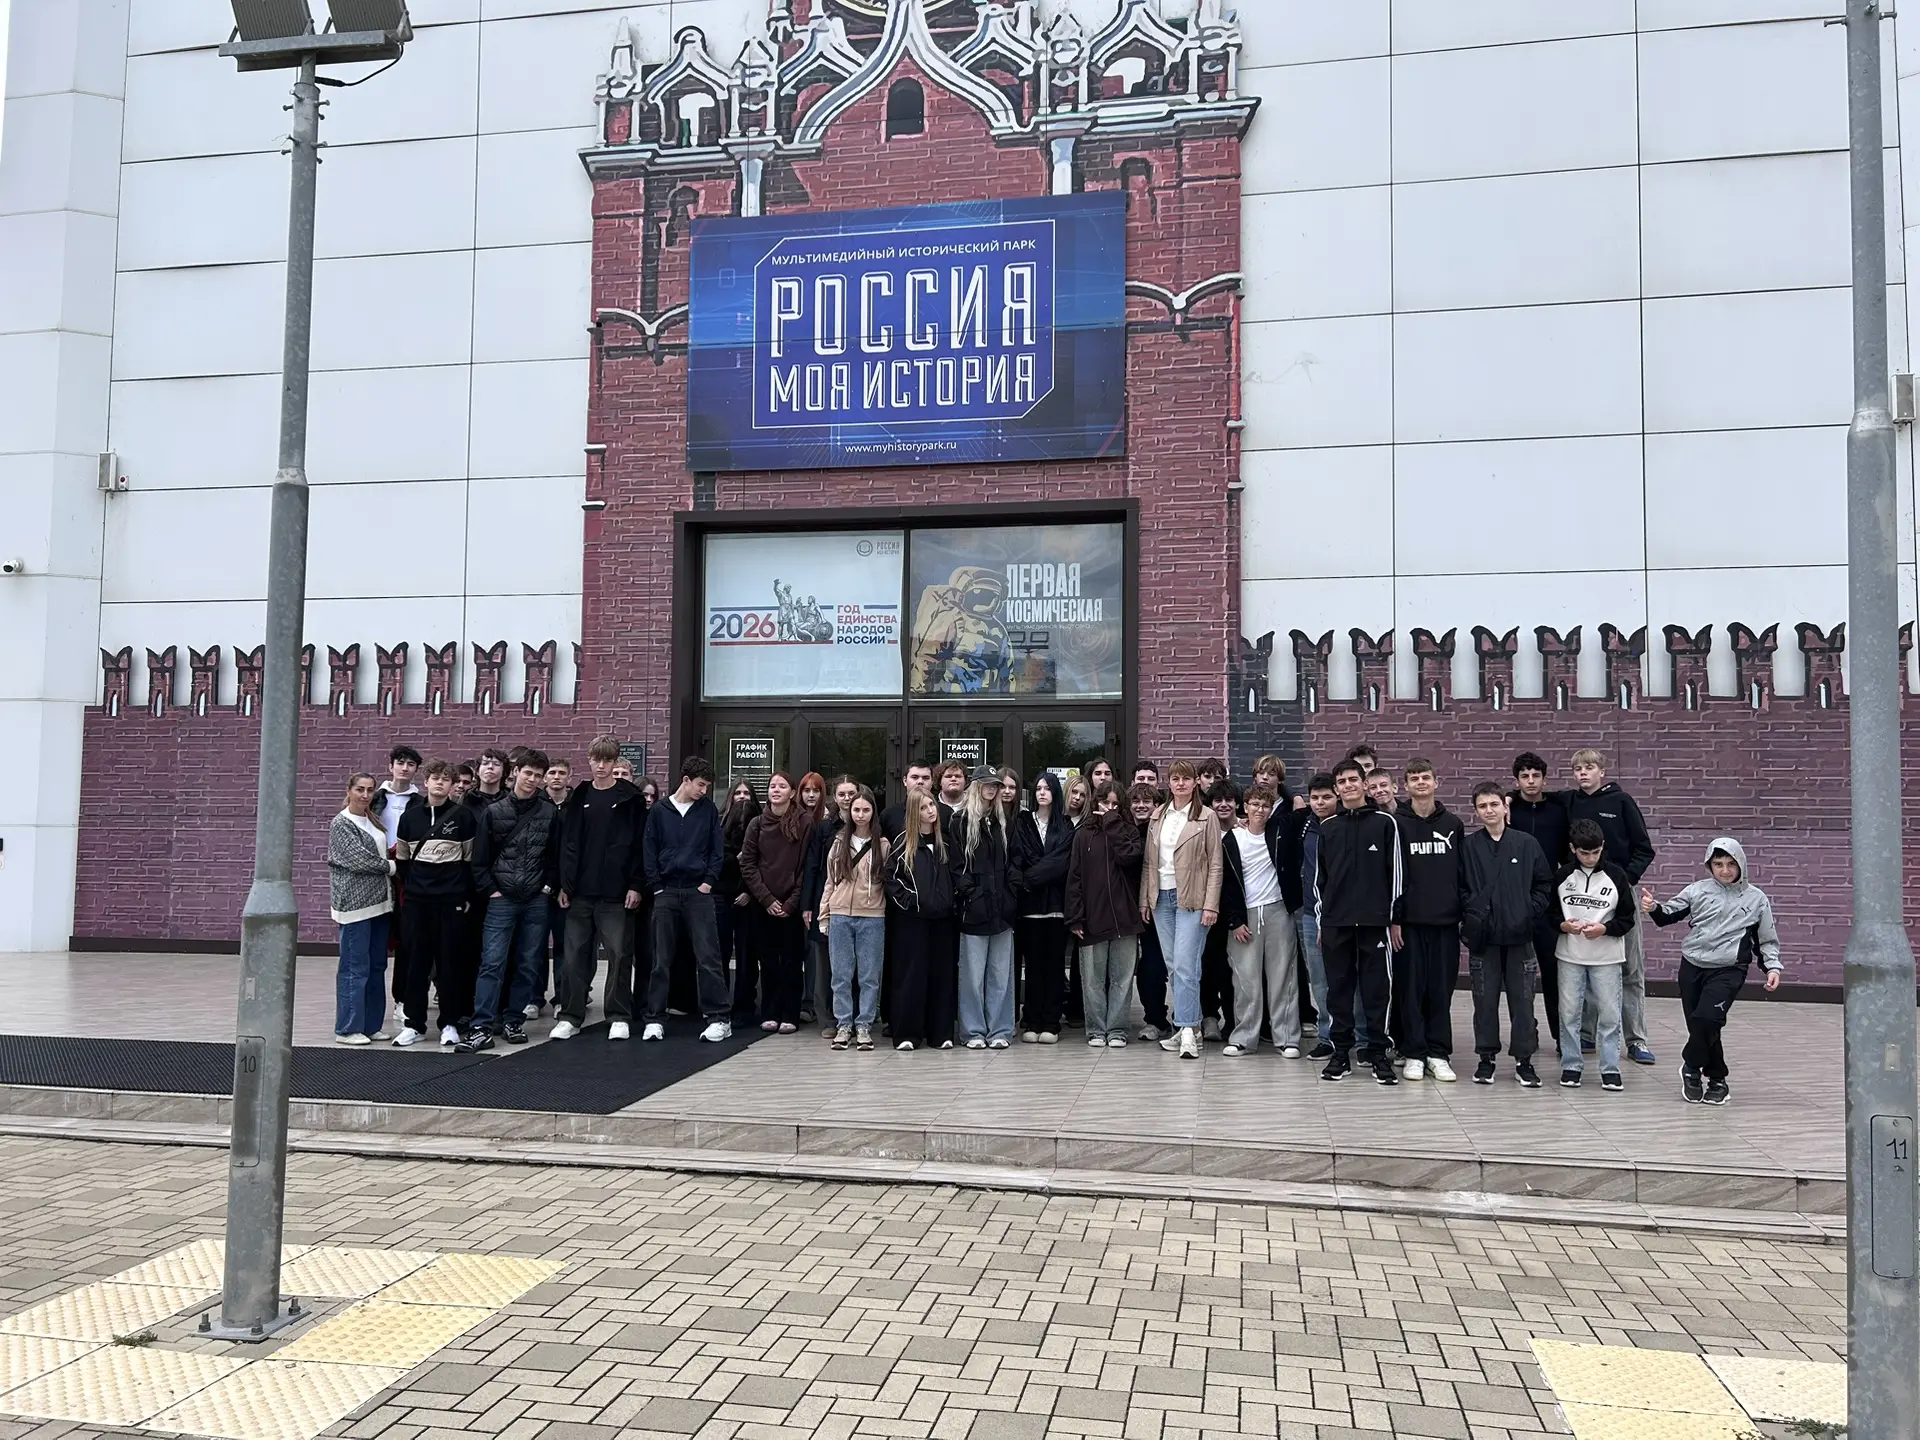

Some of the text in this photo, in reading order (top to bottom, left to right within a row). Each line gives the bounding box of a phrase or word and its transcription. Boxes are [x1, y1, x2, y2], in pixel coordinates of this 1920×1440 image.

[771, 239, 1037, 266] МУЛЬТИМЕДИЙНЫЙ ИСТОРИЧЕСКИЙ ПАРК
[770, 261, 1036, 358] РОССИЯ
[769, 352, 1036, 413] МОЯ ИСТОРИЯ
[844, 440, 957, 454] www.myhistorypark.ru
[1006, 562, 1081, 598] ПЕРВАЯ
[837, 604, 861, 615] ГОД
[1006, 598, 1103, 623] КОСМИЧЕСКАЯ
[709, 613, 776, 639] 2026
[837, 615, 898, 625] ЕДИНСТВА
[837, 625, 893, 636] НАРОДОВ
[836, 635, 886, 645] РОССИИ
[736, 743, 768, 751] ГРАФИК
[947, 743, 979, 751] ГРАФИК
[1409, 841, 1446, 855] PUMA
[1599, 887, 1613, 896] 01
[1567, 896, 1608, 907] STRONGER
[240, 1055, 257, 1073] 10
[1886, 1137, 1908, 1160] 11
